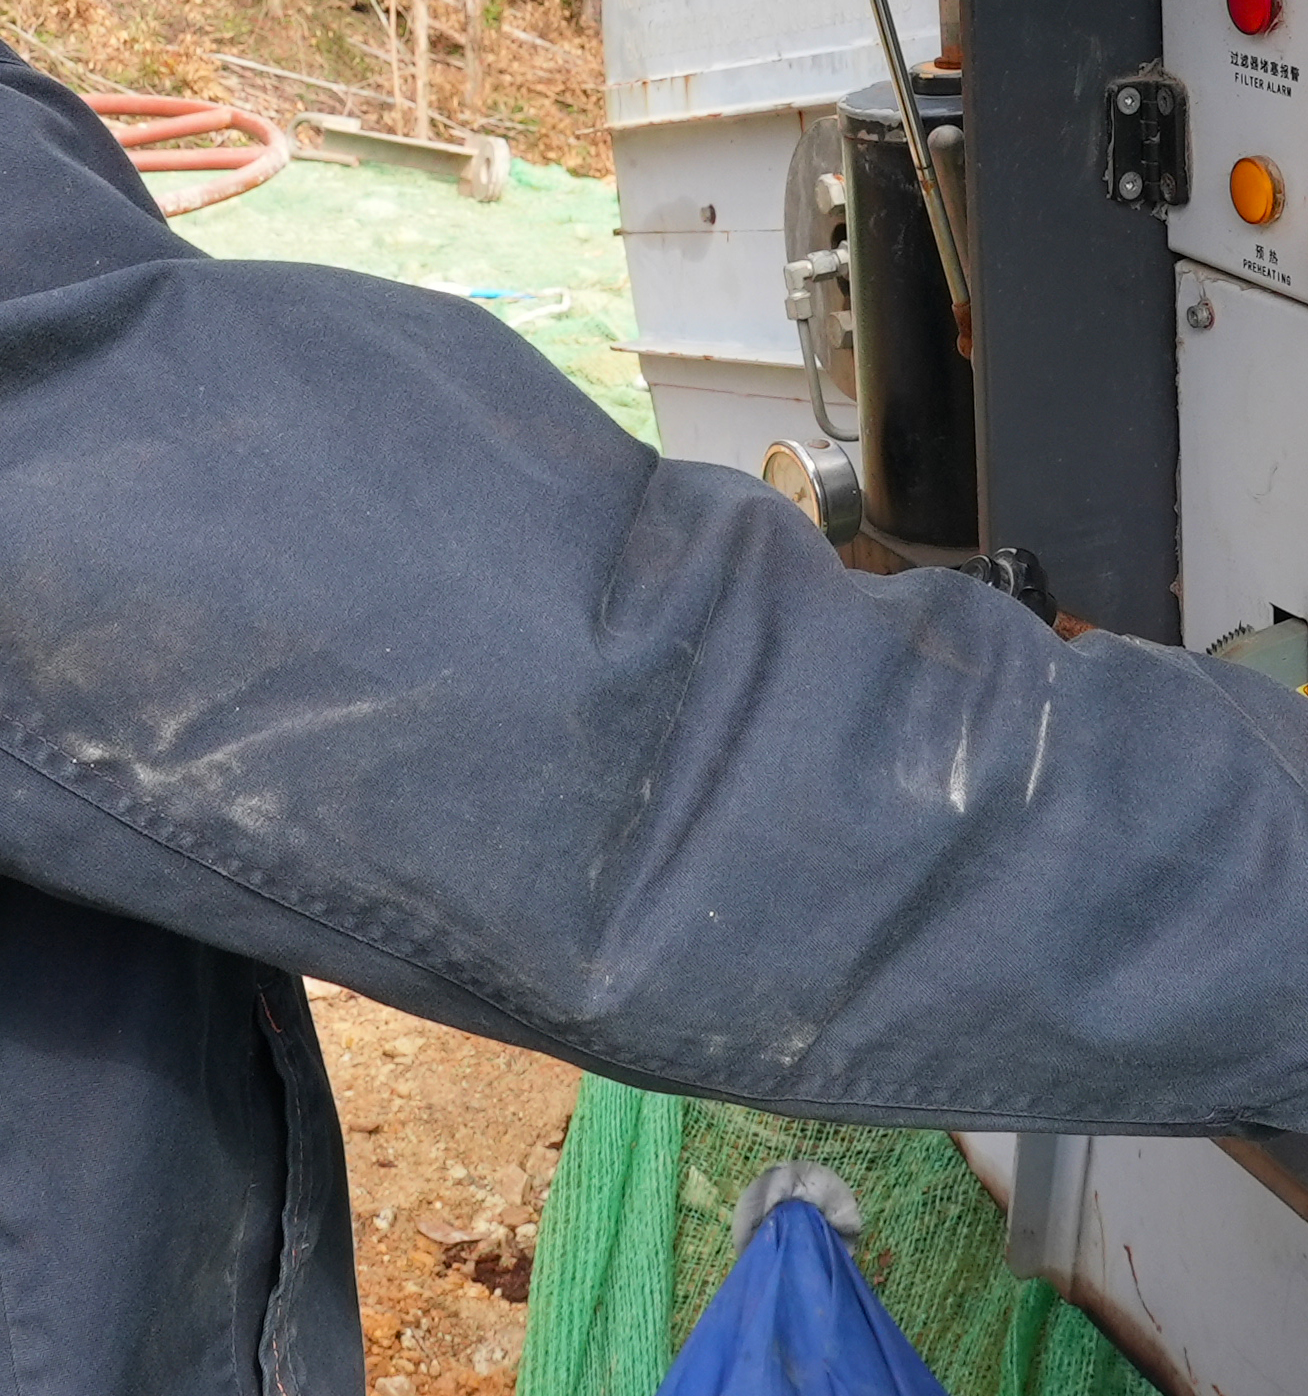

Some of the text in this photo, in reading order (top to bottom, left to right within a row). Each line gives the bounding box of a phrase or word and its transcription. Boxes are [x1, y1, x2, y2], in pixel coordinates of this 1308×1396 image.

[1230, 50, 1300, 84] 过滤器堵塞报警
[1234, 71, 1293, 98] FILTER ALARM
[1254, 244, 1279, 266] 预热
[1242, 258, 1292, 287] PREHEATING
